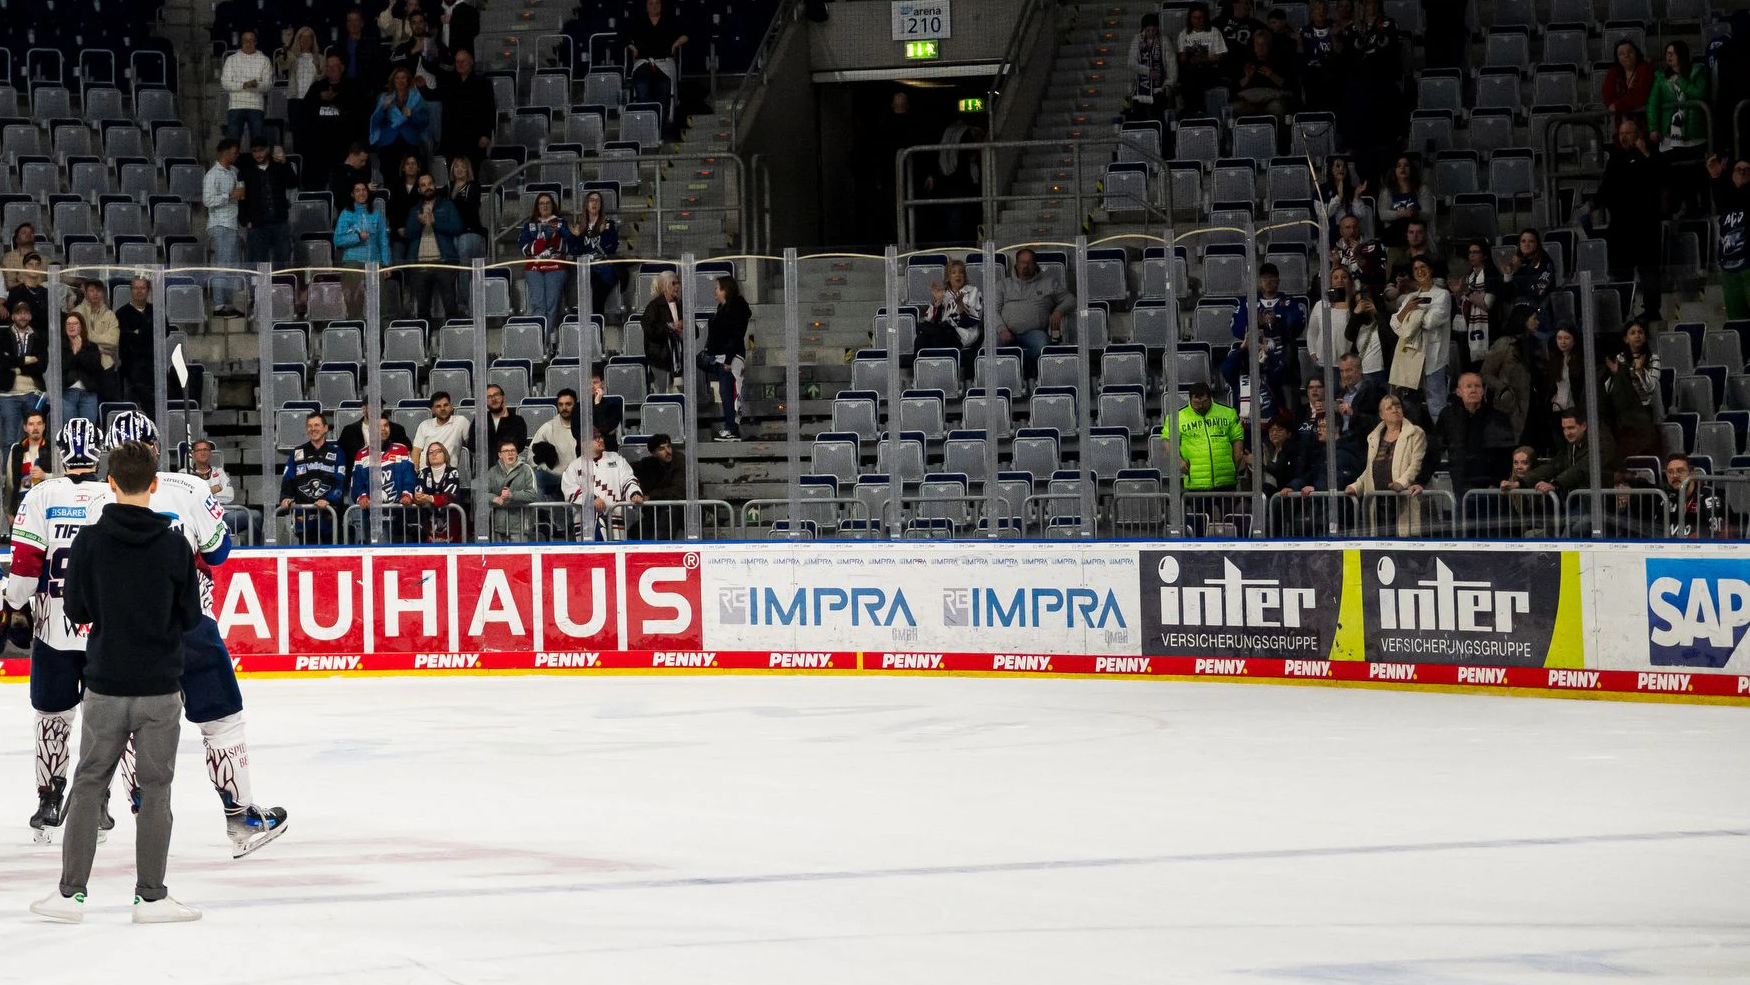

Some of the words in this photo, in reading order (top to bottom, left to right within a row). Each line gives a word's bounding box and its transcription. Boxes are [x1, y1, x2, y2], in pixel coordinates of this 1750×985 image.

[914, 7, 941, 15] arena
[908, 17, 941, 33] 210
[1182, 421, 1203, 432] CAMP
[163, 477, 195, 491] structure
[1158, 555, 1316, 627] inter
[1377, 555, 1529, 633] inter
[750, 587, 917, 626] IMPRA
[972, 587, 1127, 628] IMPRA
[1649, 576, 1750, 647] SAP
[1161, 633, 1317, 650] VERSICHERUNGSGRUPPE
[1381, 638, 1531, 657] VERSICHERUNGSGRUPPE
